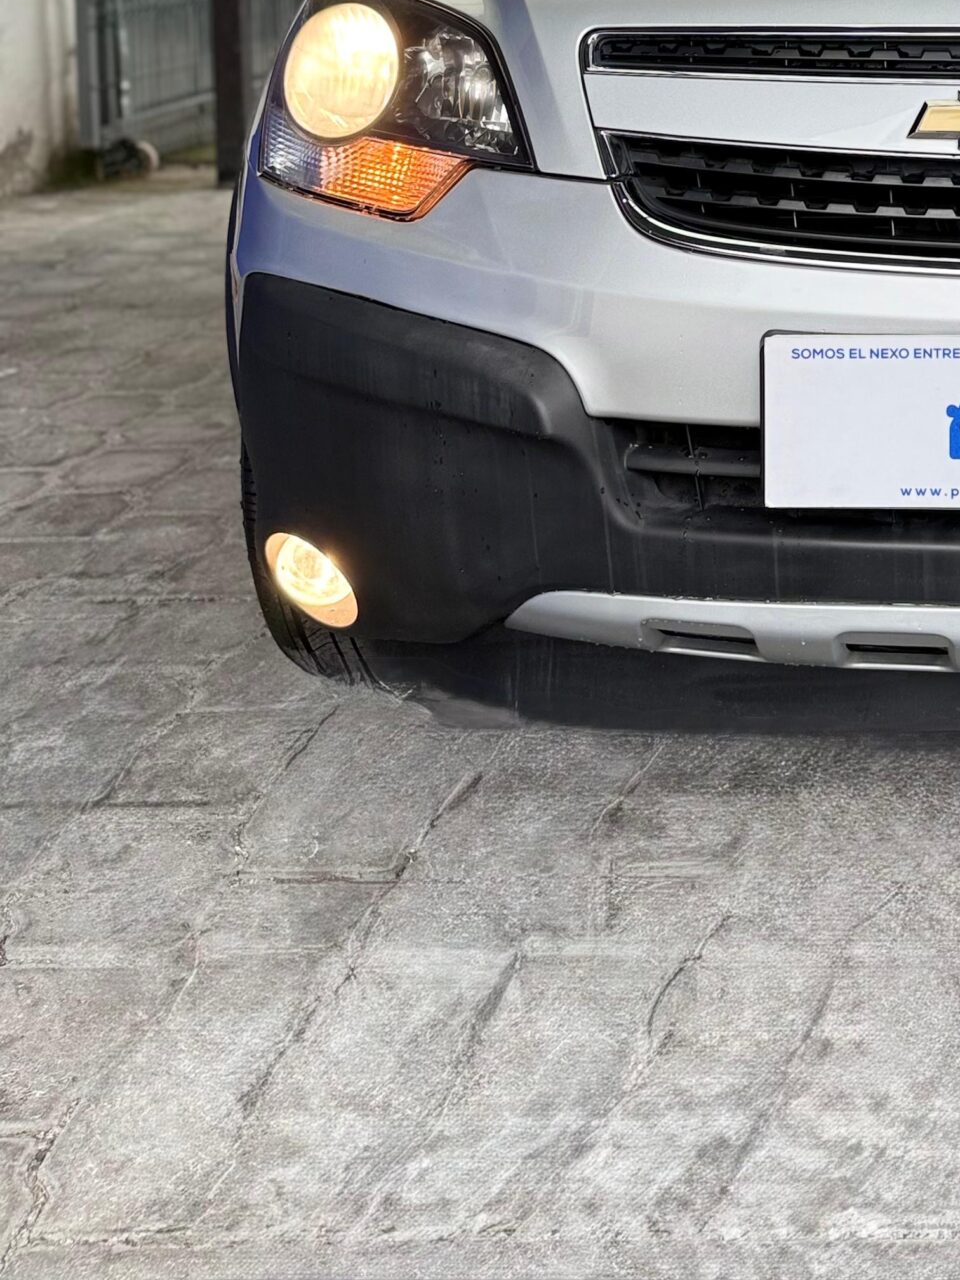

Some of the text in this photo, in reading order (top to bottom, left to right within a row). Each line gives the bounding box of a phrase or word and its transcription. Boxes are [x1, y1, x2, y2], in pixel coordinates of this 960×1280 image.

[791, 348, 845, 360] SOMOS
[850, 348, 867, 359] EL
[869, 348, 910, 360] NEXO
[914, 348, 960, 359] ENTRE
